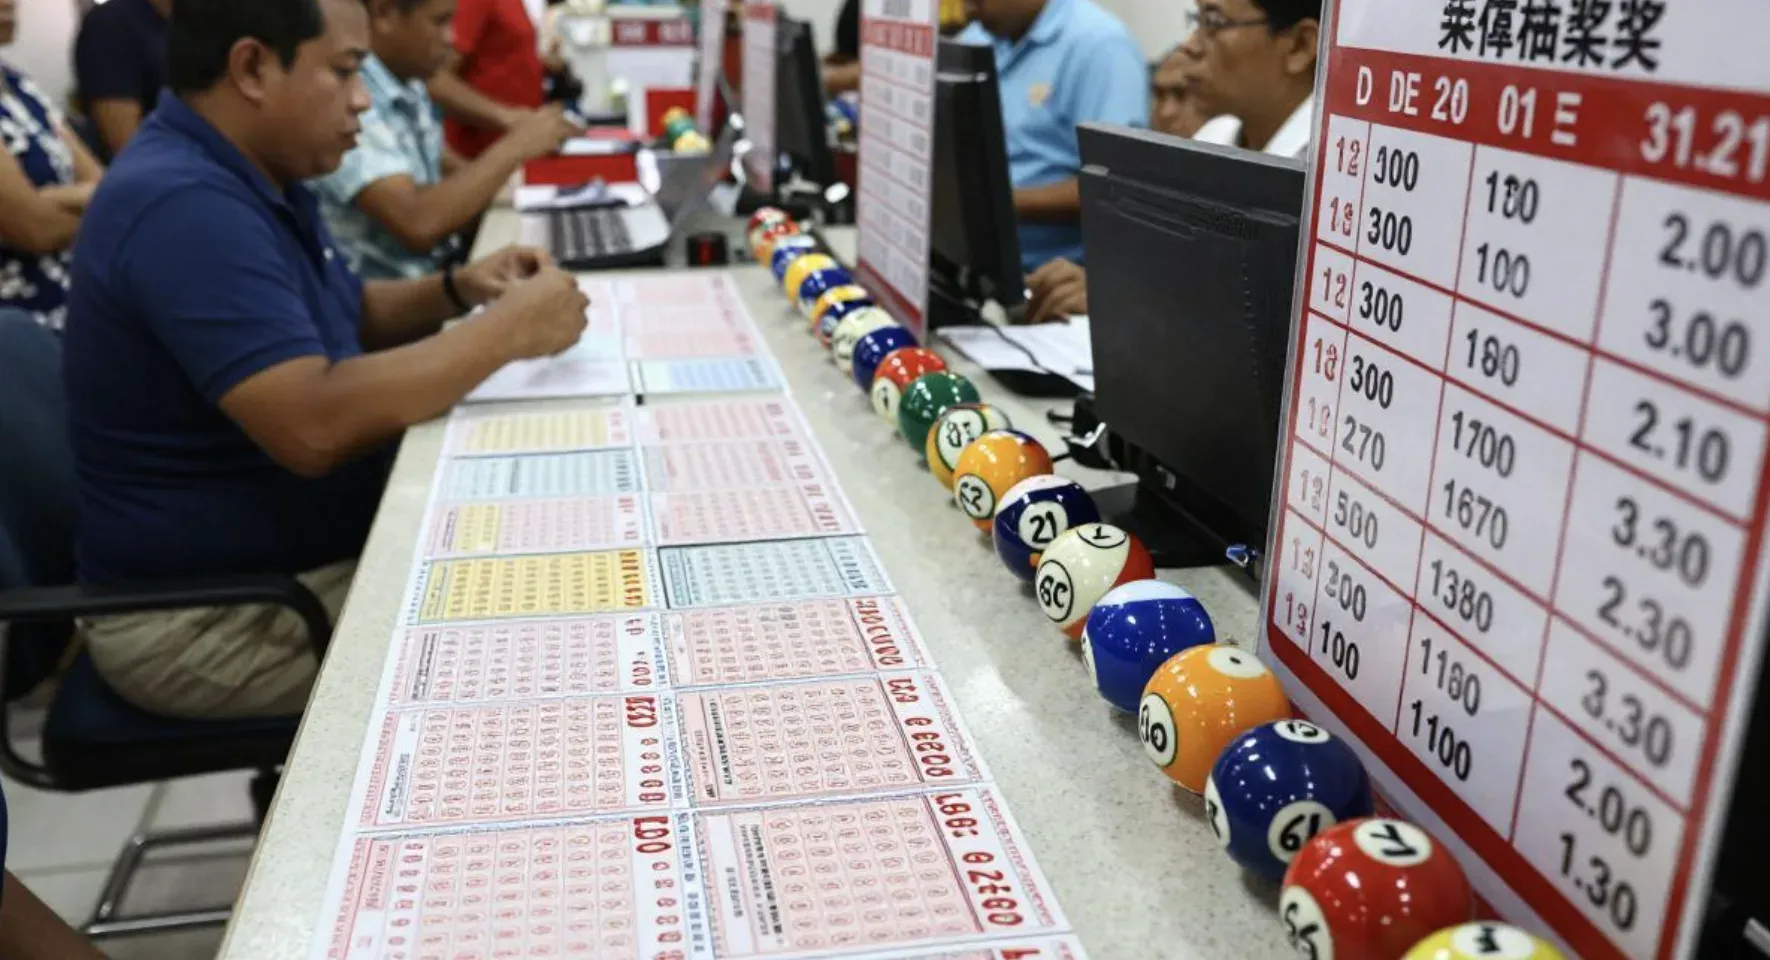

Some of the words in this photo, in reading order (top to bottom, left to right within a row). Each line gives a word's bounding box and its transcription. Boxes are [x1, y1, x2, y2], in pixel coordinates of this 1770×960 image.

[1356, 66, 1373, 106] D
[1388, 70, 1422, 116] DE
[1431, 75, 1469, 124] 20
[1497, 84, 1537, 139] 01
[1639, 101, 1770, 183] 31.21
[1367, 207, 1412, 256] 300
[1477, 243, 1530, 298] 100
[1644, 298, 1750, 379] 3.00
[1658, 212, 1767, 289] 2.00
[1359, 281, 1403, 332] 300
[1628, 399, 1730, 485] 2.10
[1029, 512, 1058, 544] 21
[1342, 415, 1385, 472] 270
[1443, 478, 1508, 550] 1670
[1598, 575, 1693, 671] 2.30
[1350, 355, 1393, 410] 300
[1452, 410, 1515, 478] 1700
[1612, 496, 1712, 588] 3.30
[1334, 489, 1378, 549] 500
[1431, 559, 1493, 633] 1380
[1321, 620, 1360, 681] 100
[1411, 699, 1472, 782] 1100
[1559, 832, 1637, 932] 1.30
[1565, 758, 1652, 859] 2.00
